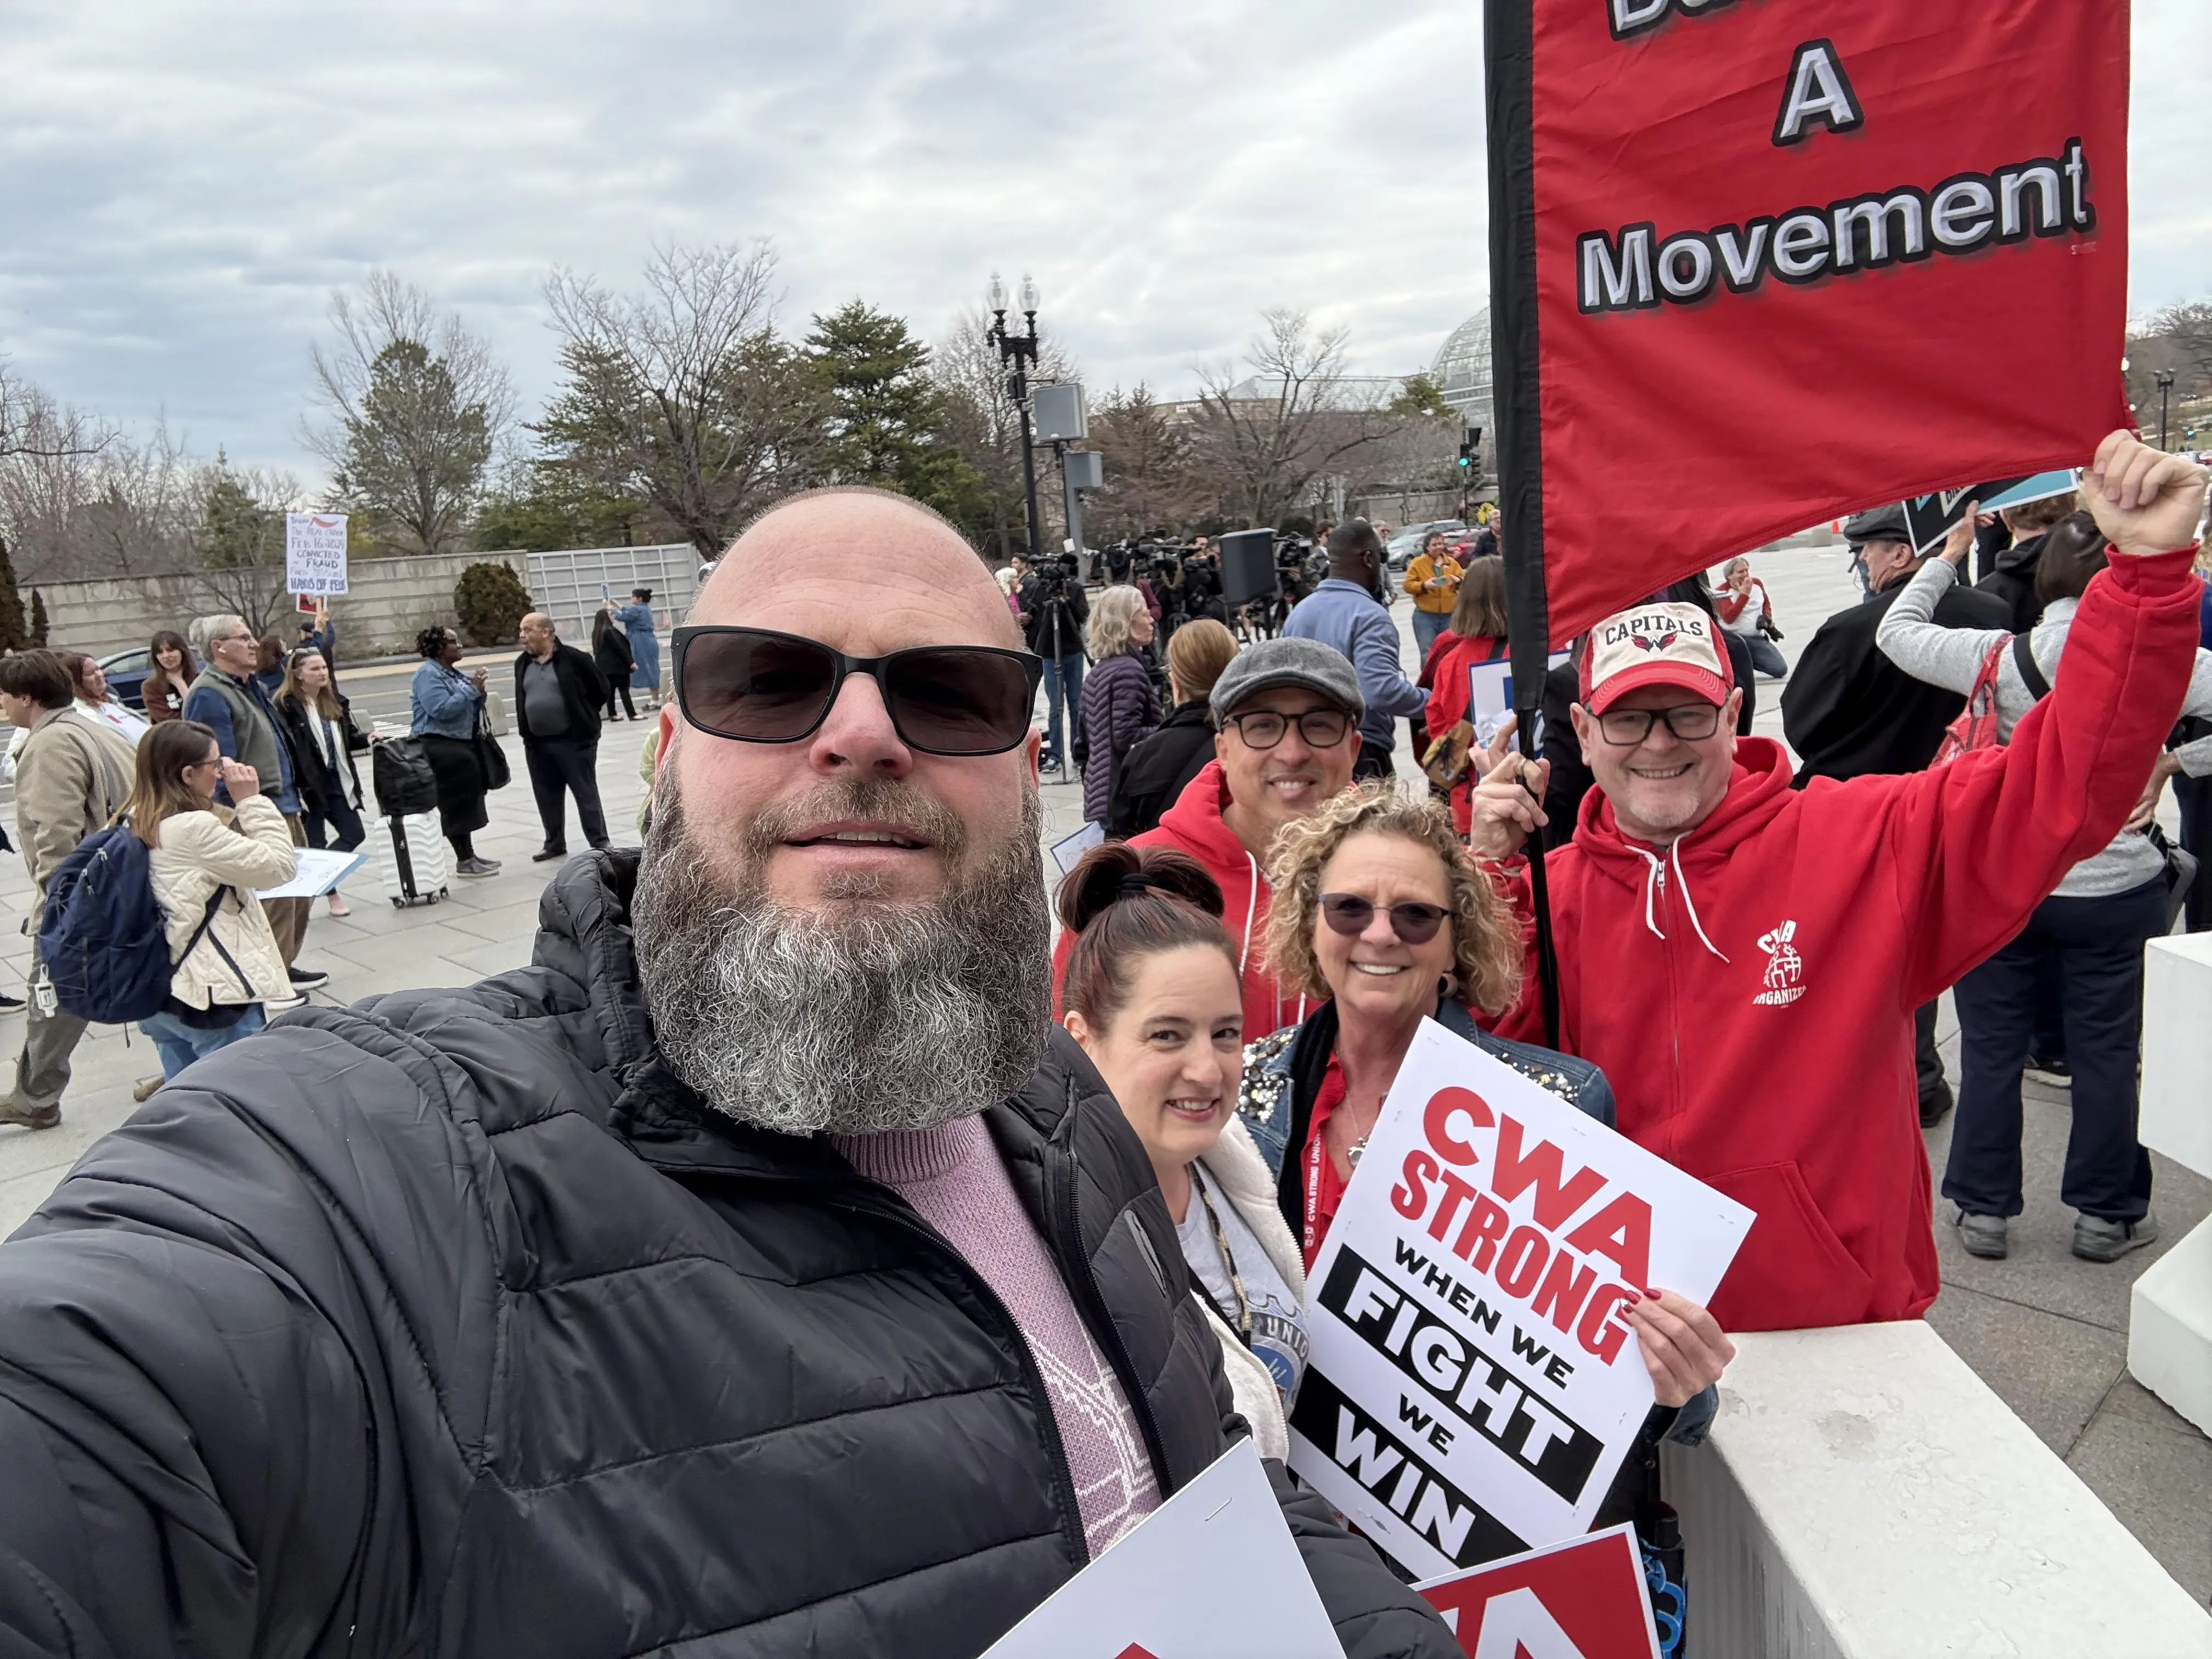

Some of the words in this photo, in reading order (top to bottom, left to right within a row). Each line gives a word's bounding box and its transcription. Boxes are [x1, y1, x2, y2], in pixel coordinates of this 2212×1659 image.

[1778, 45, 1858, 141] A
[1581, 142, 2090, 310] Movement
[306, 558, 338, 569] FRAUD
[1605, 615, 1704, 646] CAPITALS
[1307, 1197, 1317, 1222] CWA
[1424, 1087, 1662, 1301] CWA
[1391, 1150, 1642, 1365] STRONG
[1396, 1237, 1502, 1335] WHEN
[1512, 1325, 1575, 1390] WE
[1267, 1316, 1308, 1358] UNIO
[1343, 1267, 1575, 1466] FIGHT
[1335, 1405, 1476, 1560] WIN
[1399, 1393, 1455, 1457] WE
